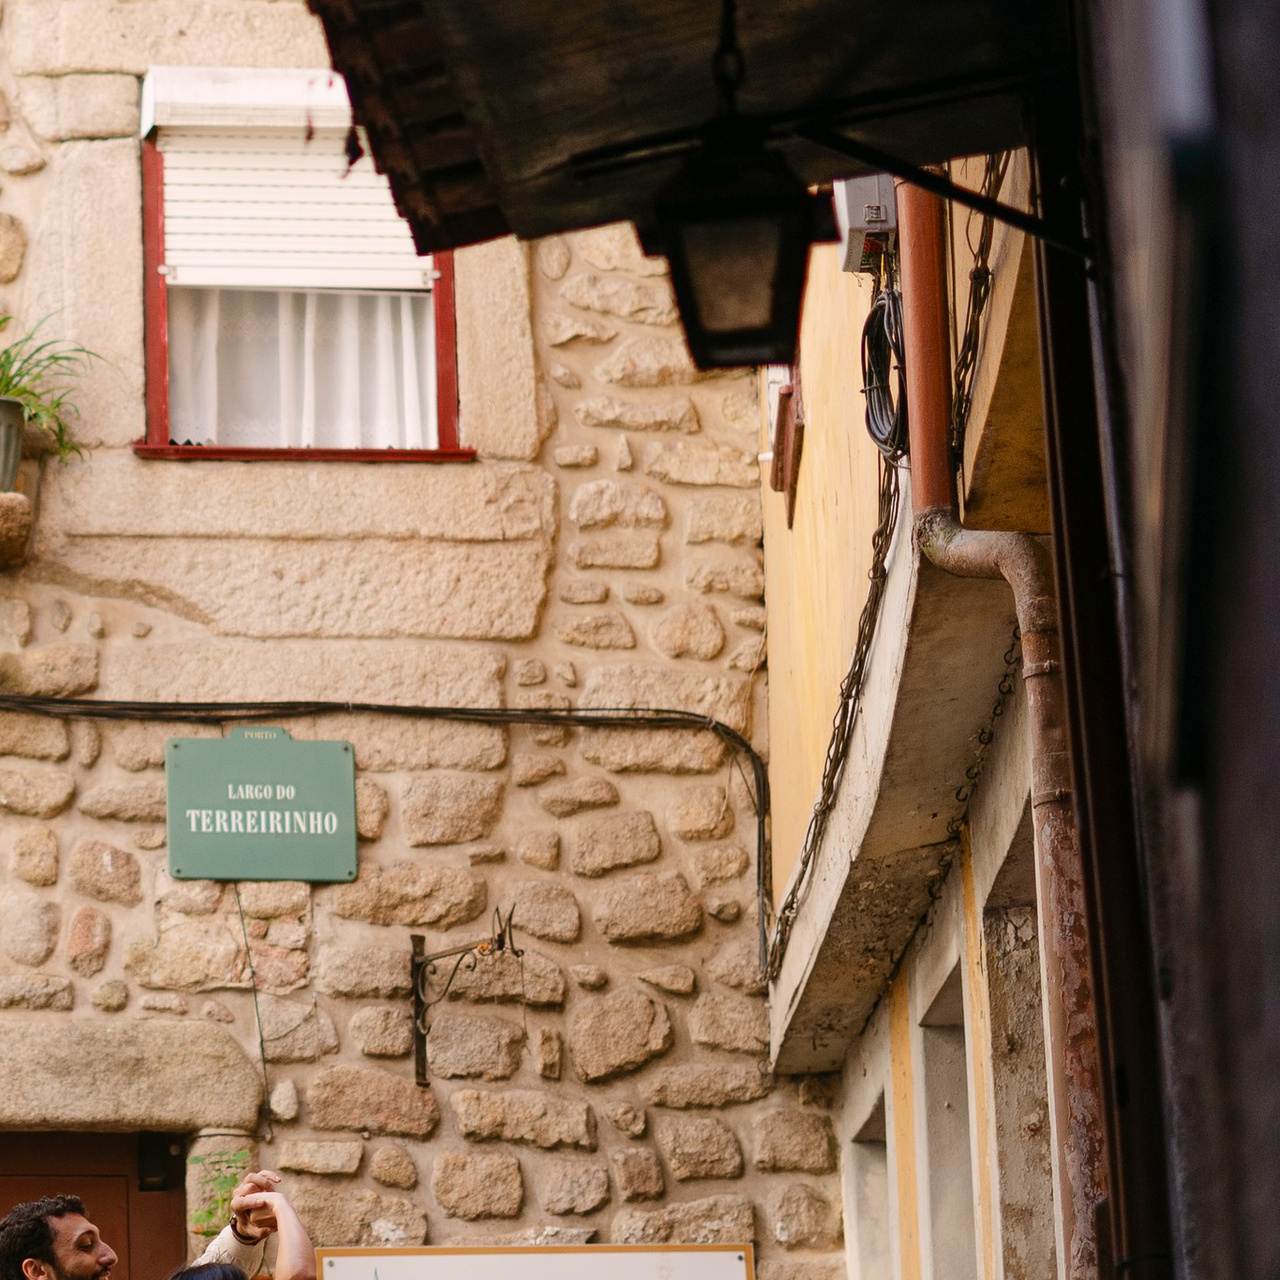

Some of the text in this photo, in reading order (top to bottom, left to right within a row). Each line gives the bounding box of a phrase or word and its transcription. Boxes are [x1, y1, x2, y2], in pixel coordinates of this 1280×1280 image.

[228, 784, 295, 800] LARGO DO
[186, 810, 338, 834] TERREIRINHO
